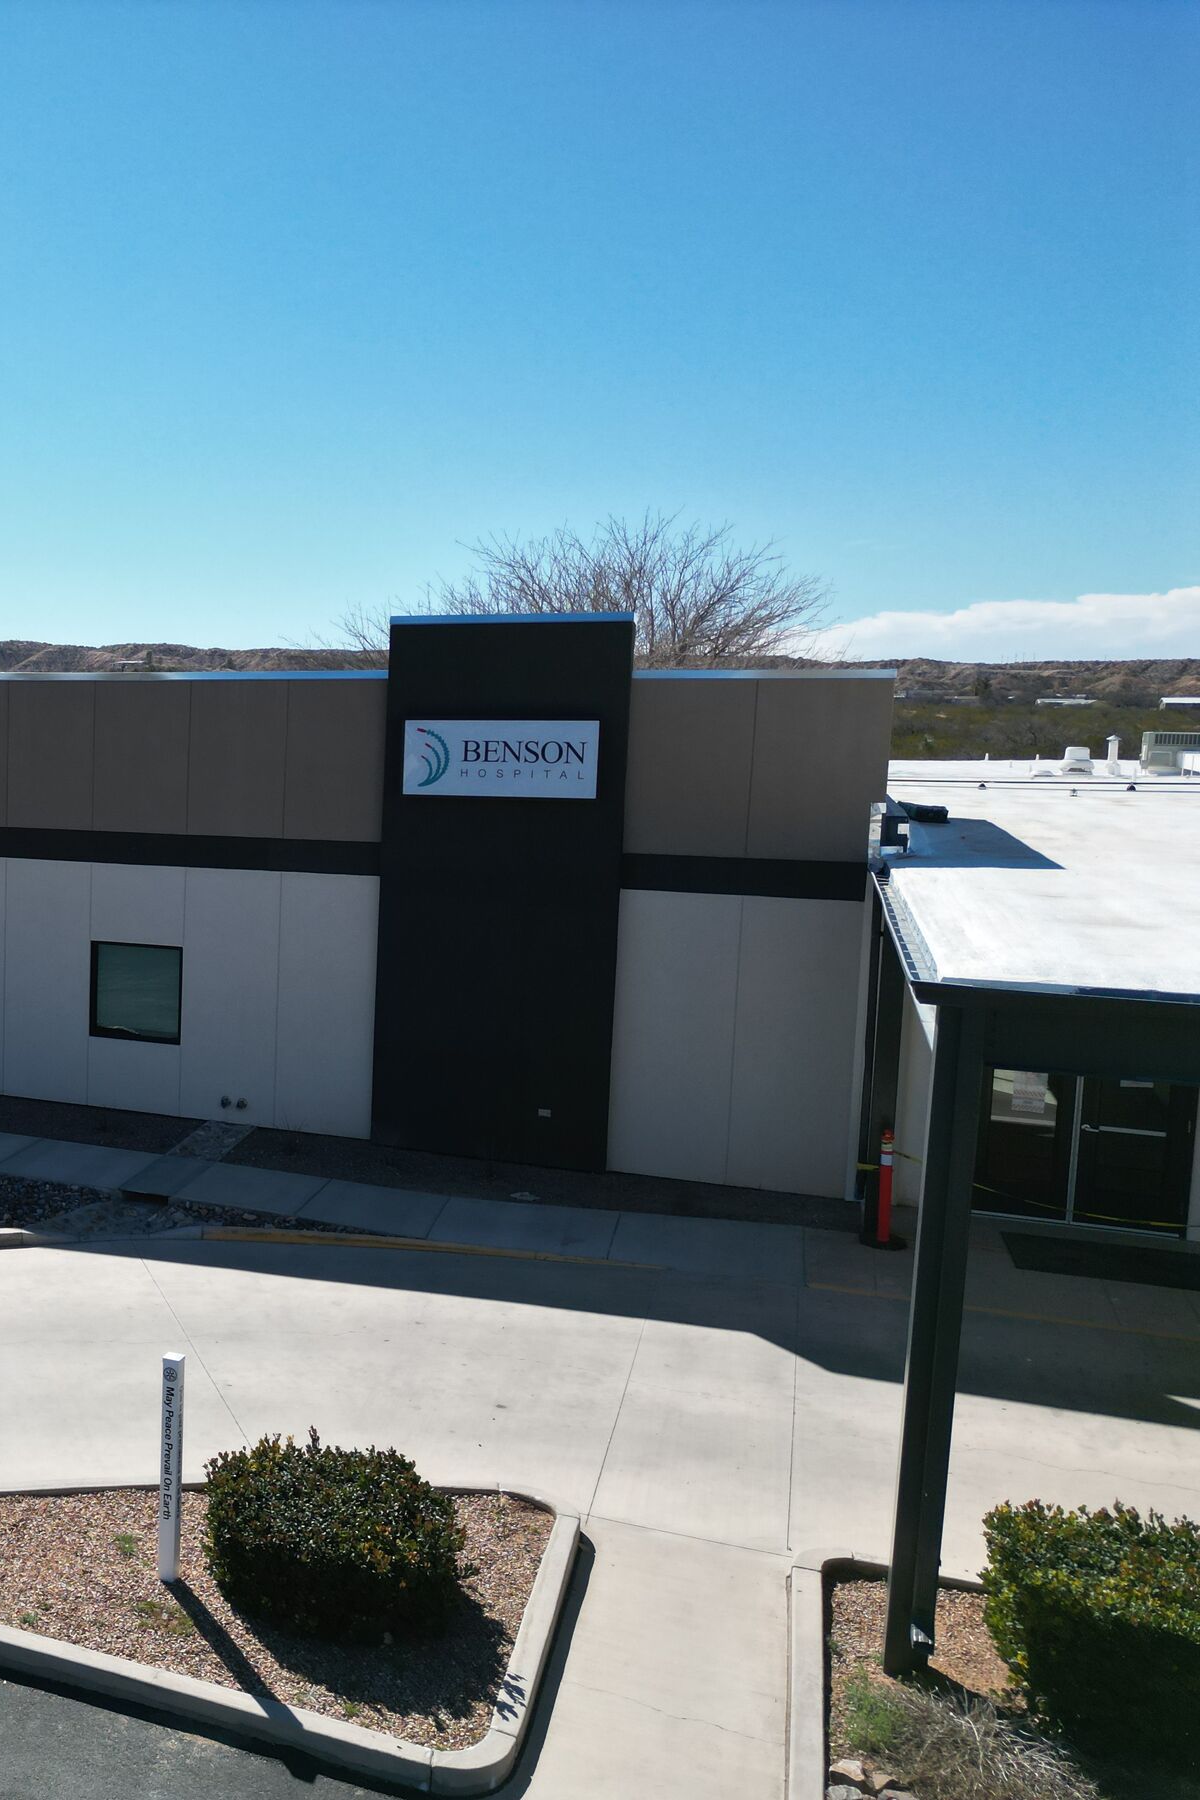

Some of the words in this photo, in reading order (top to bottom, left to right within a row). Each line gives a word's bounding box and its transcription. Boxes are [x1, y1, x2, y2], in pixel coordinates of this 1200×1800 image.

[461, 740, 588, 765] BENSON
[460, 768, 585, 780] HOSPITAL
[164, 1386, 175, 1408] May
[164, 1409, 174, 1440] Peace
[164, 1442, 174, 1476] Prevail
[163, 1477, 173, 1492] On
[162, 1493, 172, 1520] Earth
